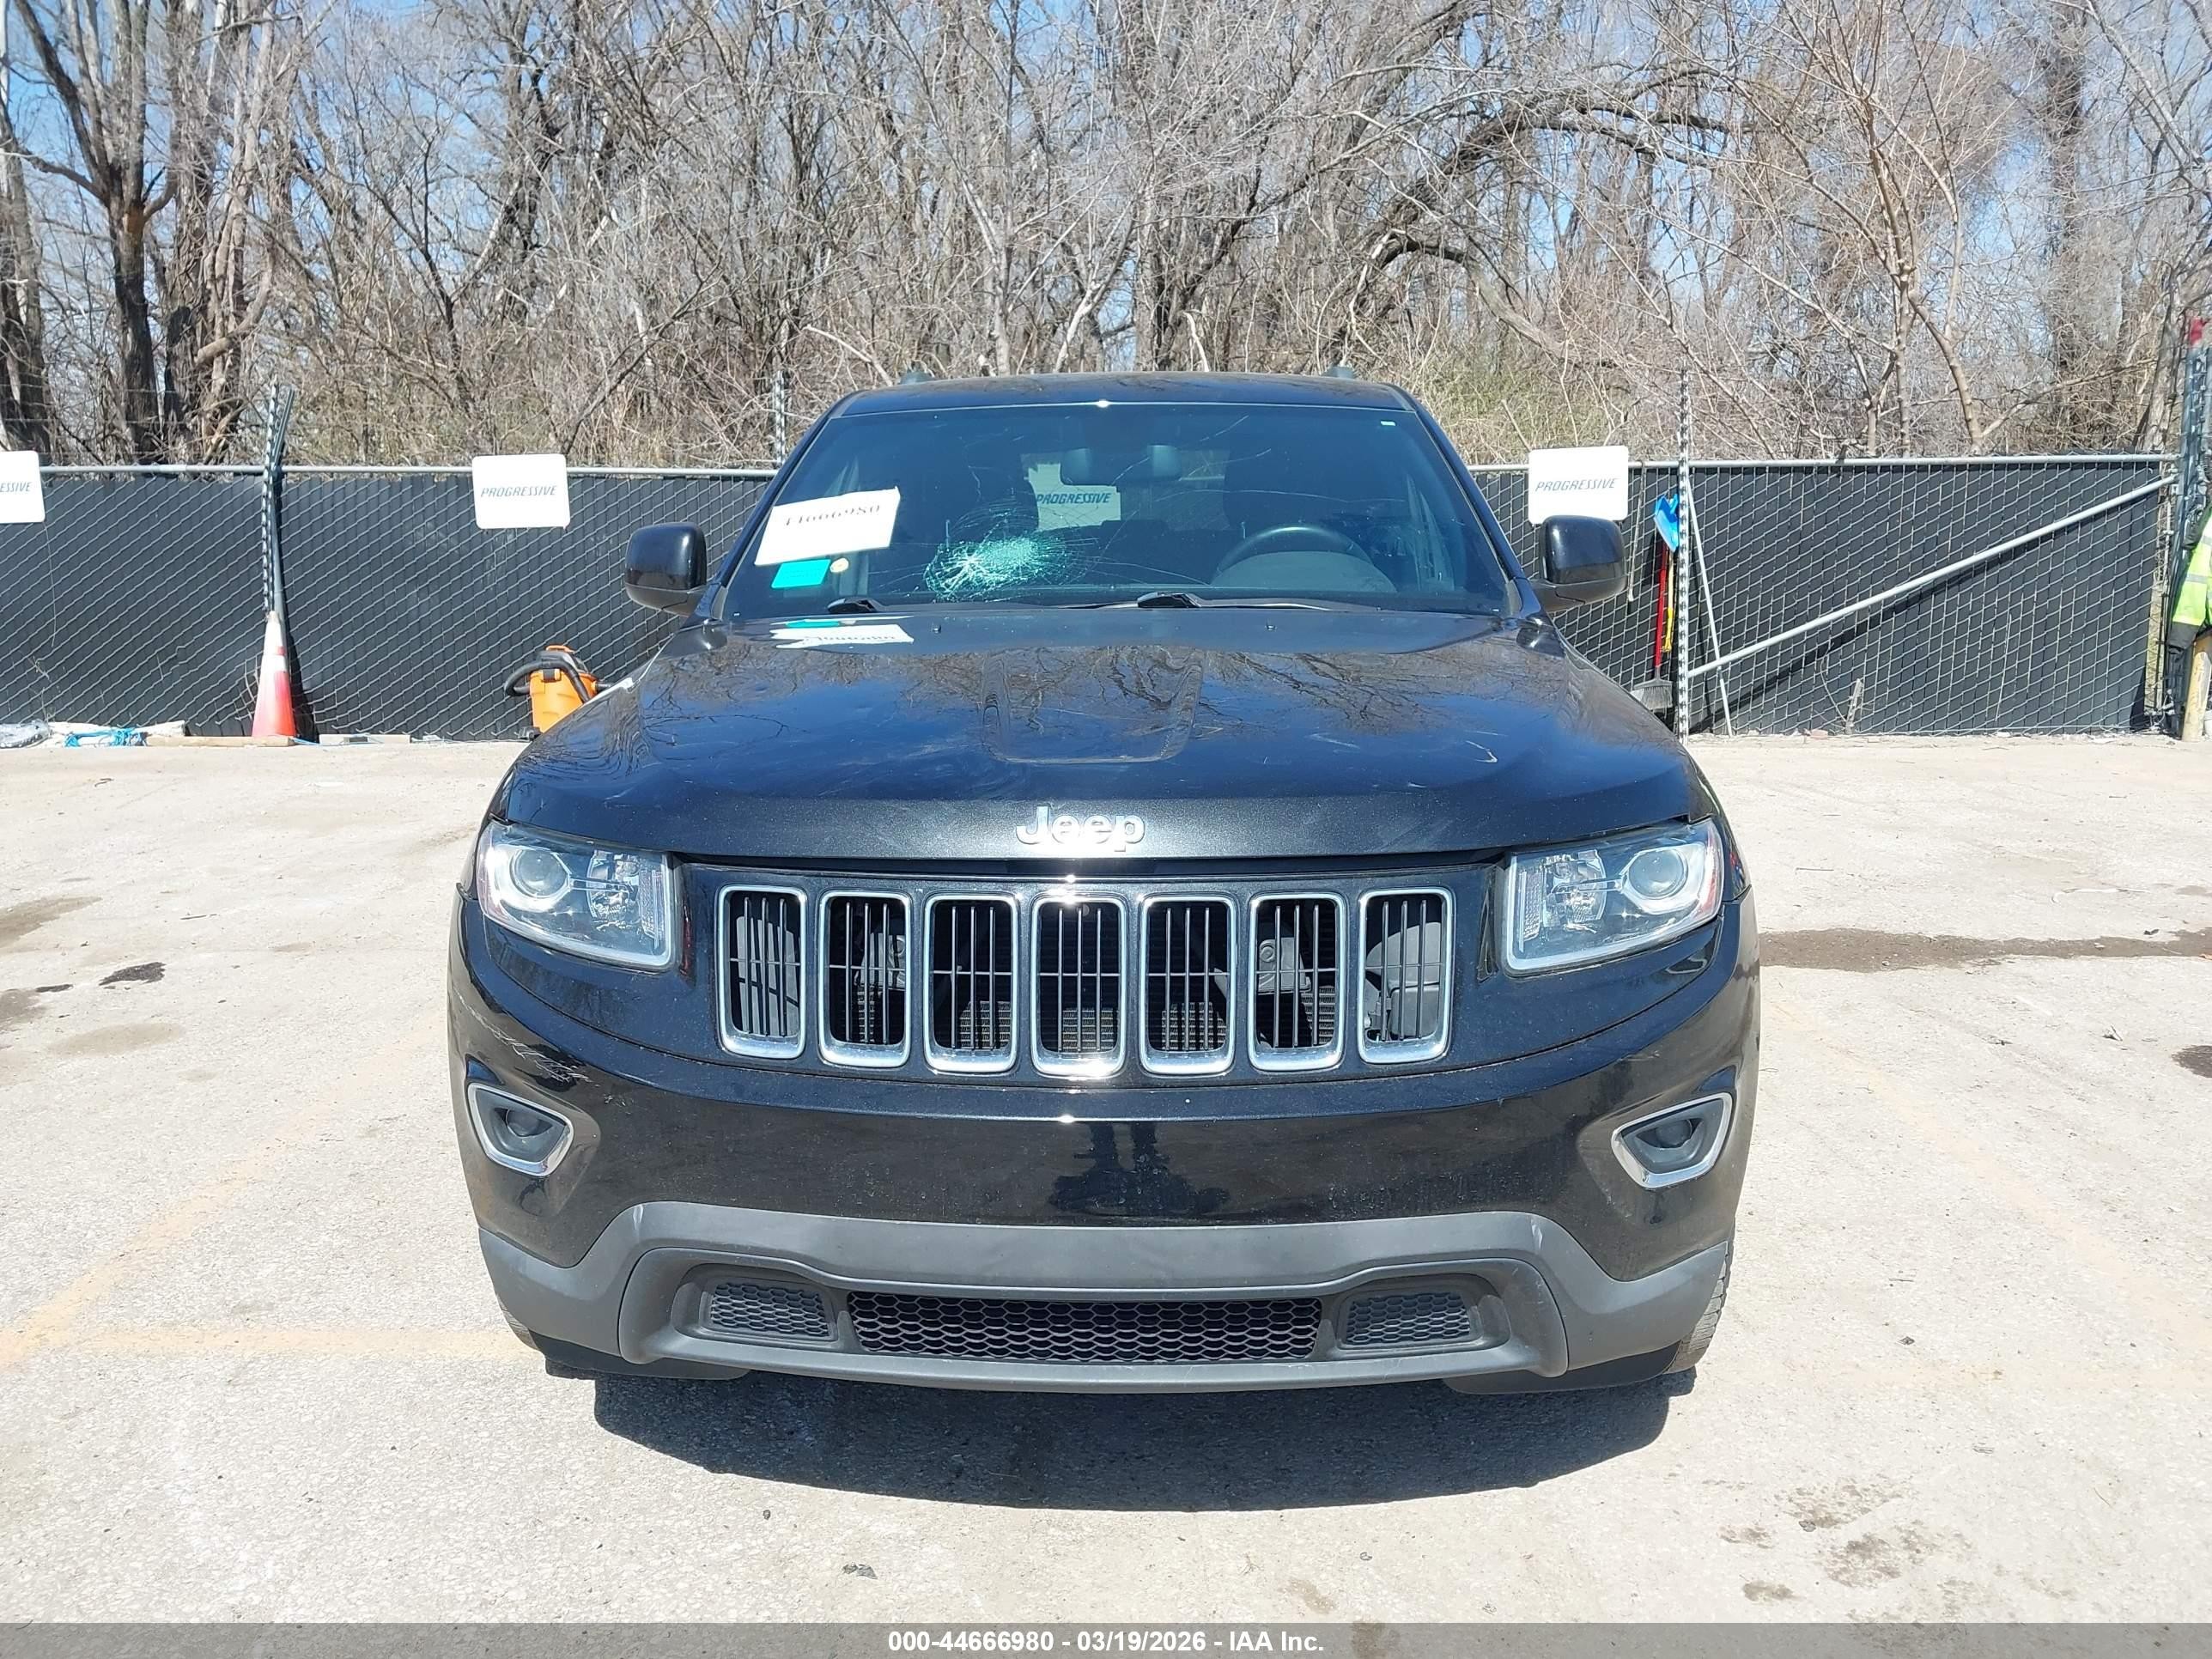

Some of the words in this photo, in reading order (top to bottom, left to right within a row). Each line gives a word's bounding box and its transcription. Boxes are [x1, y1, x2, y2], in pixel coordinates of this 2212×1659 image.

[481, 485, 556, 497] PROGRESSIVE
[1534, 478, 1620, 492] PROGRESSIVE
[1036, 493, 1111, 505] PROGRESSIVE
[1016, 805, 1145, 852] Jeep
